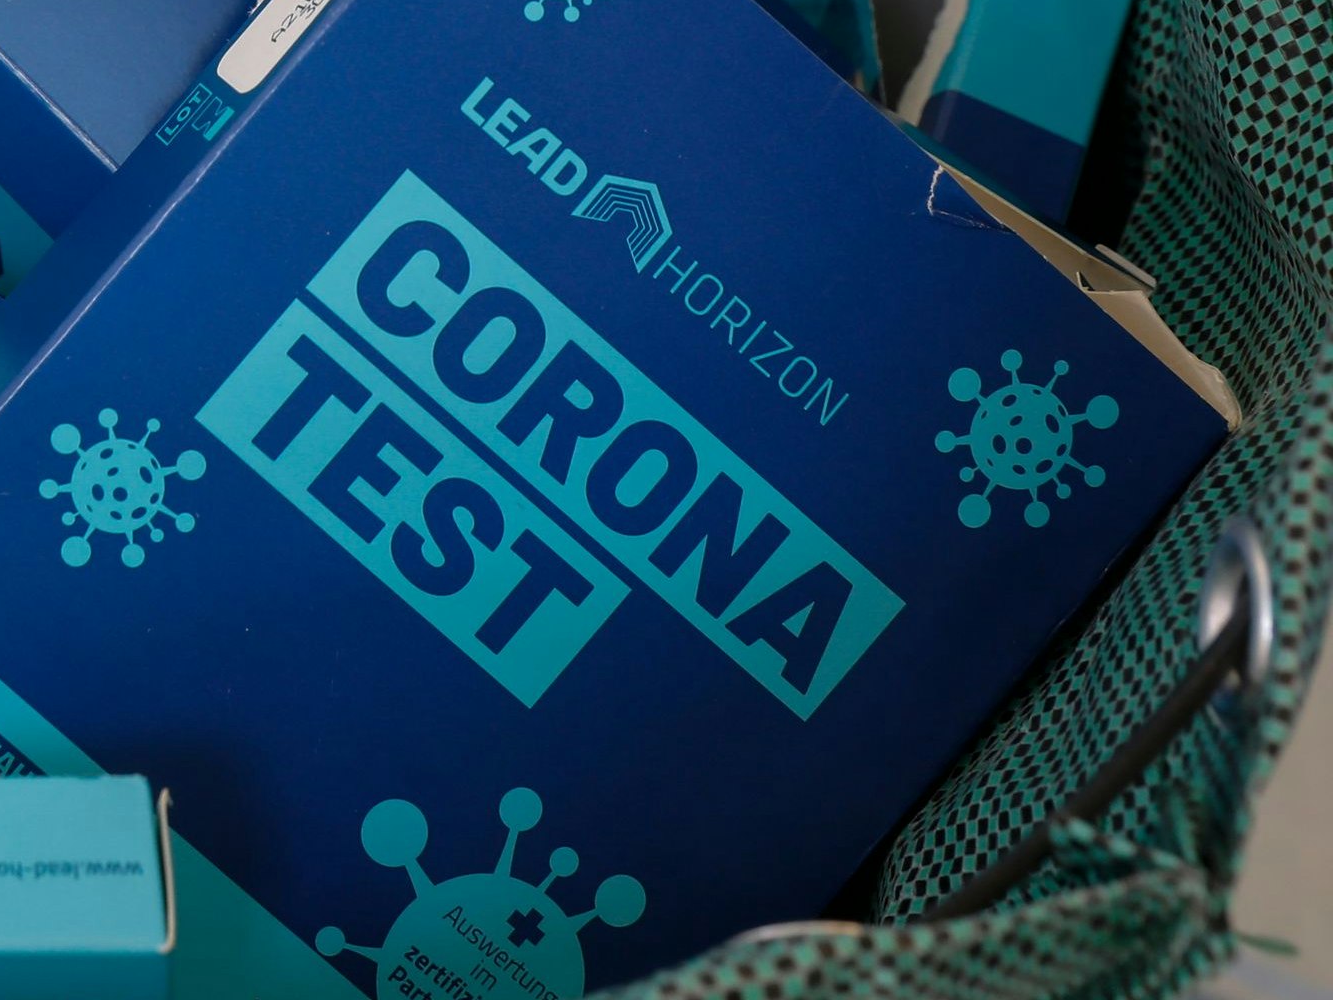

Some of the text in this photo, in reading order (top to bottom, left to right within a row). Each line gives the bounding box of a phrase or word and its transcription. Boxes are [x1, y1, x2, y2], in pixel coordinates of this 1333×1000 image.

[163, 90, 203, 137] LOT
[460, 76, 851, 427] LEAD HORIZON
[251, 333, 597, 657] TEST
[355, 218, 856, 697] CORONA
[469, 959, 498, 992] im
